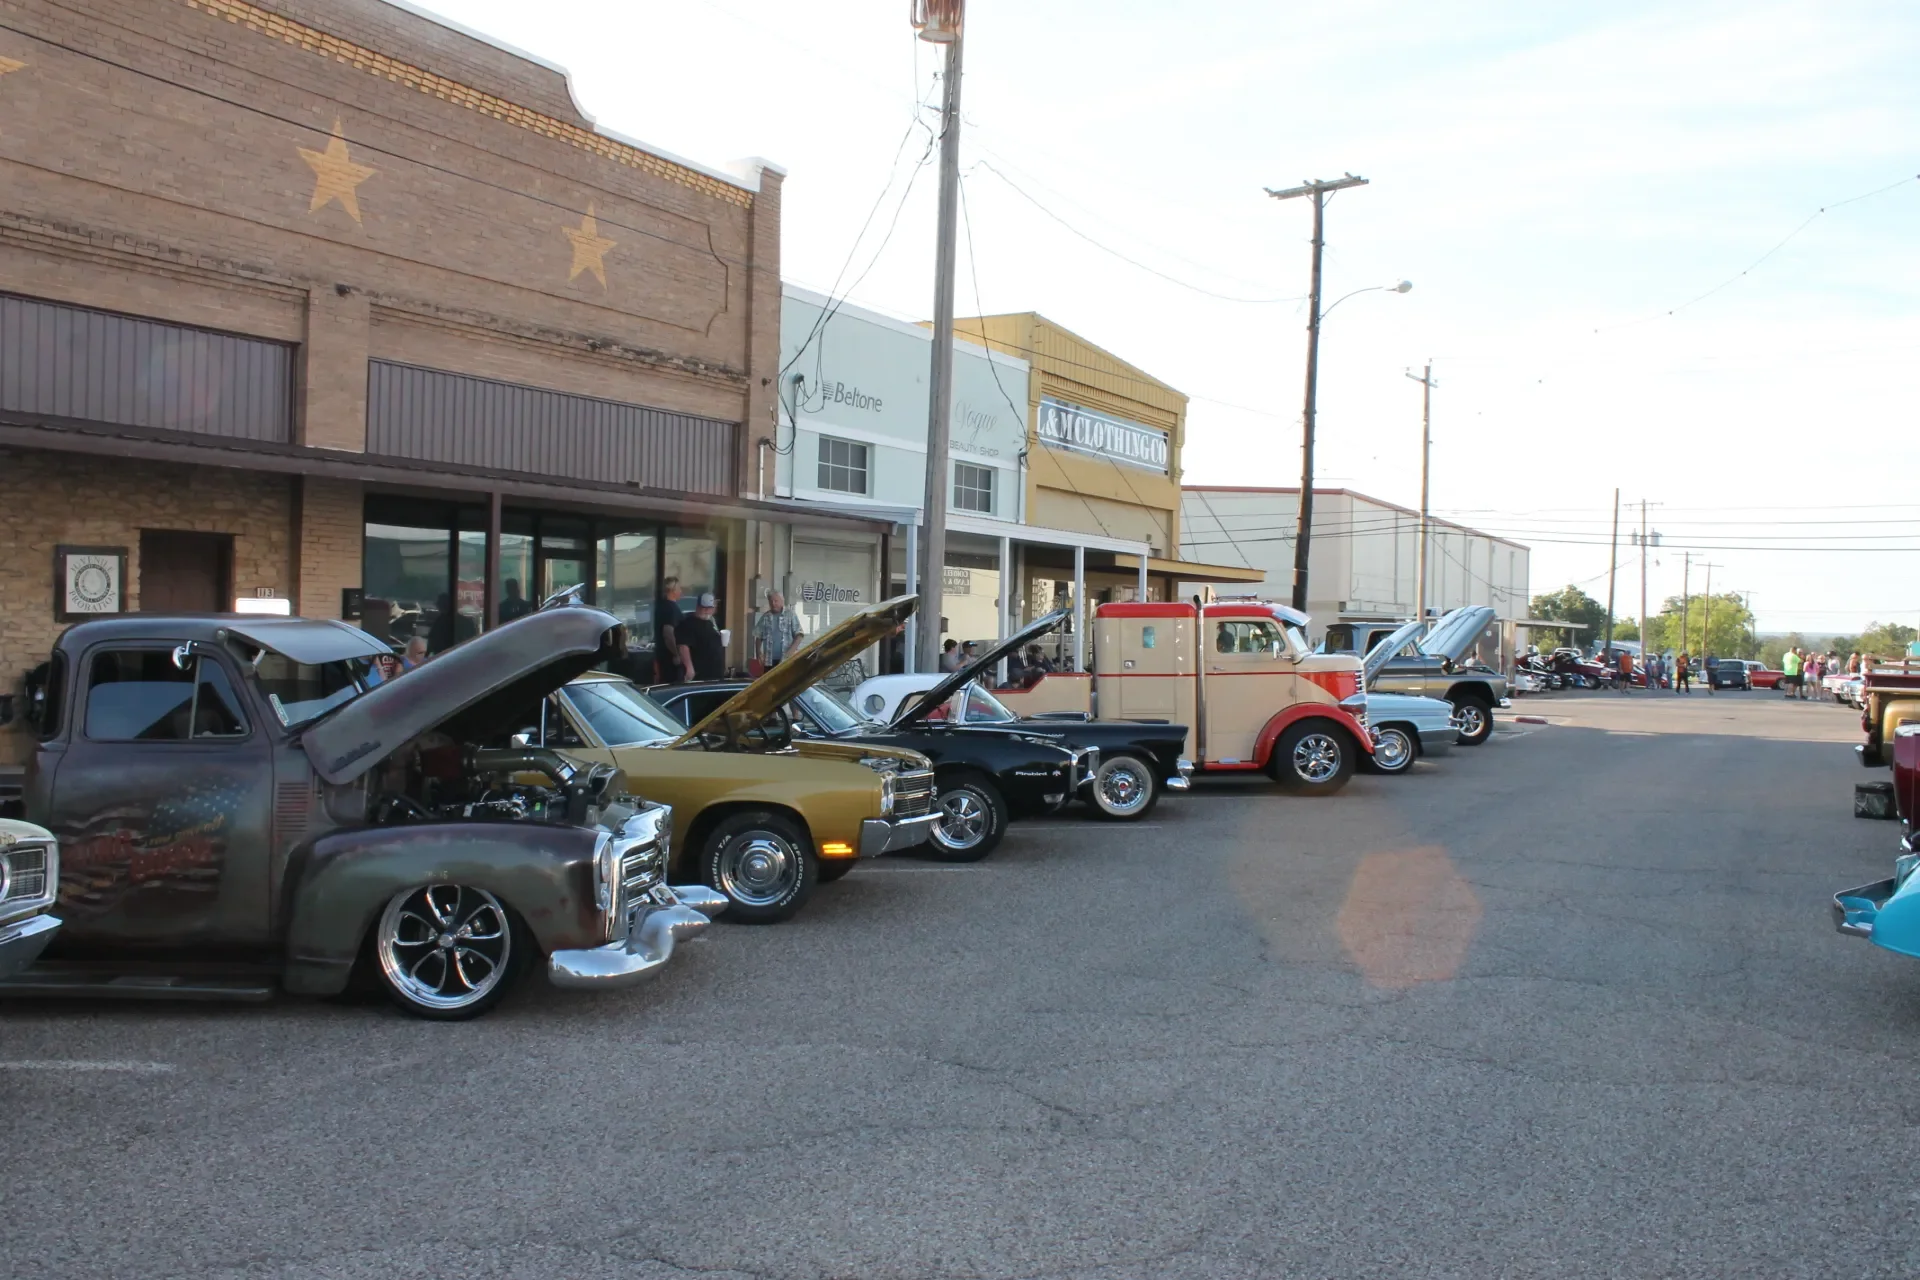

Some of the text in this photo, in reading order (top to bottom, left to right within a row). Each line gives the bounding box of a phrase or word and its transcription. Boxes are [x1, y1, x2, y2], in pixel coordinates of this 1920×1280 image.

[834, 381, 883, 412] Beltone
[955, 400, 998, 443] Vogue
[1037, 405, 1167, 464] L&M CLOTHING CO
[949, 440, 999, 457] BEAUTY SHOP
[70, 556, 113, 572] JUVENILE
[69, 590, 116, 611] PROBATION
[259, 588, 273, 598] 113
[815, 581, 860, 602] Beltone
[718, 835, 732, 849] T/A
[780, 843, 804, 906] BFGoodrich
